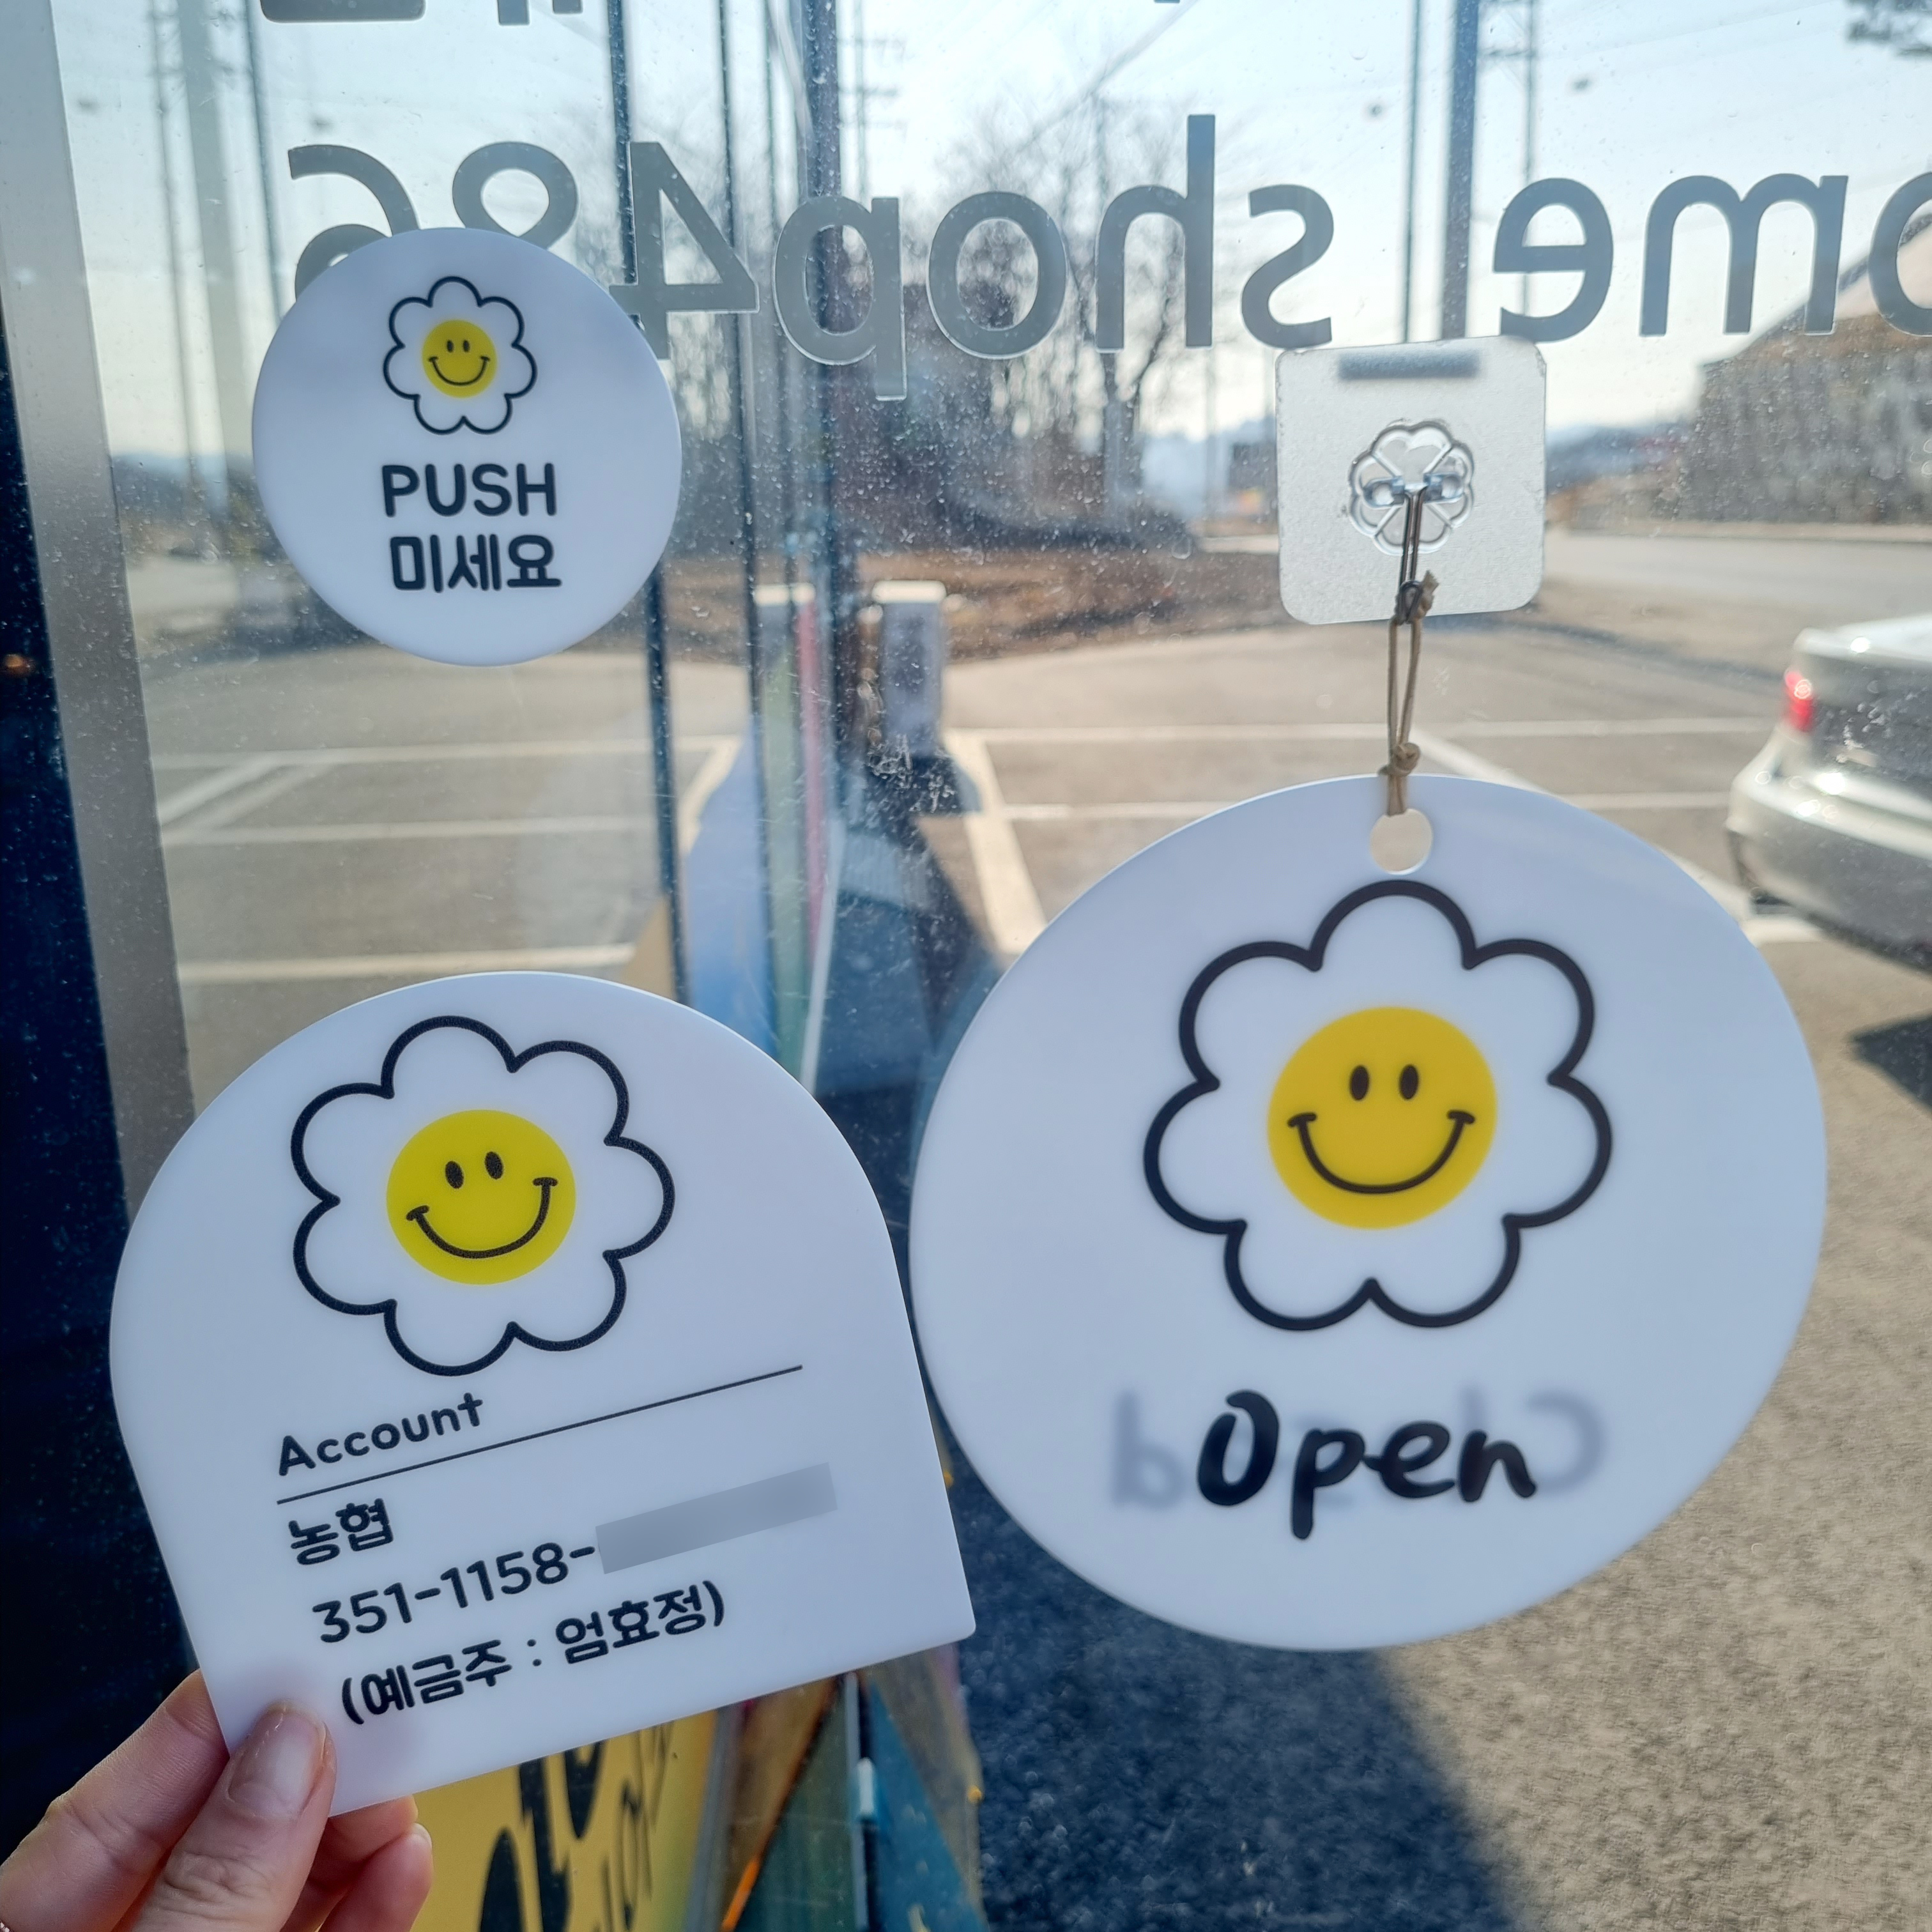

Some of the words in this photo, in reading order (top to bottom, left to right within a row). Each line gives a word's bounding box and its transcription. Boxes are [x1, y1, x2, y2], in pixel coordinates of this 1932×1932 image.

[381, 463, 556, 518] PUSH
[390, 533, 562, 594] 미세요
[279, 1392, 484, 1476] Account
[1197, 1390, 1537, 1540] Open
[288, 1498, 394, 1565] 농협
[341, 1639, 513, 1725] (예금주
[555, 1580, 725, 1664] 엄효정)
